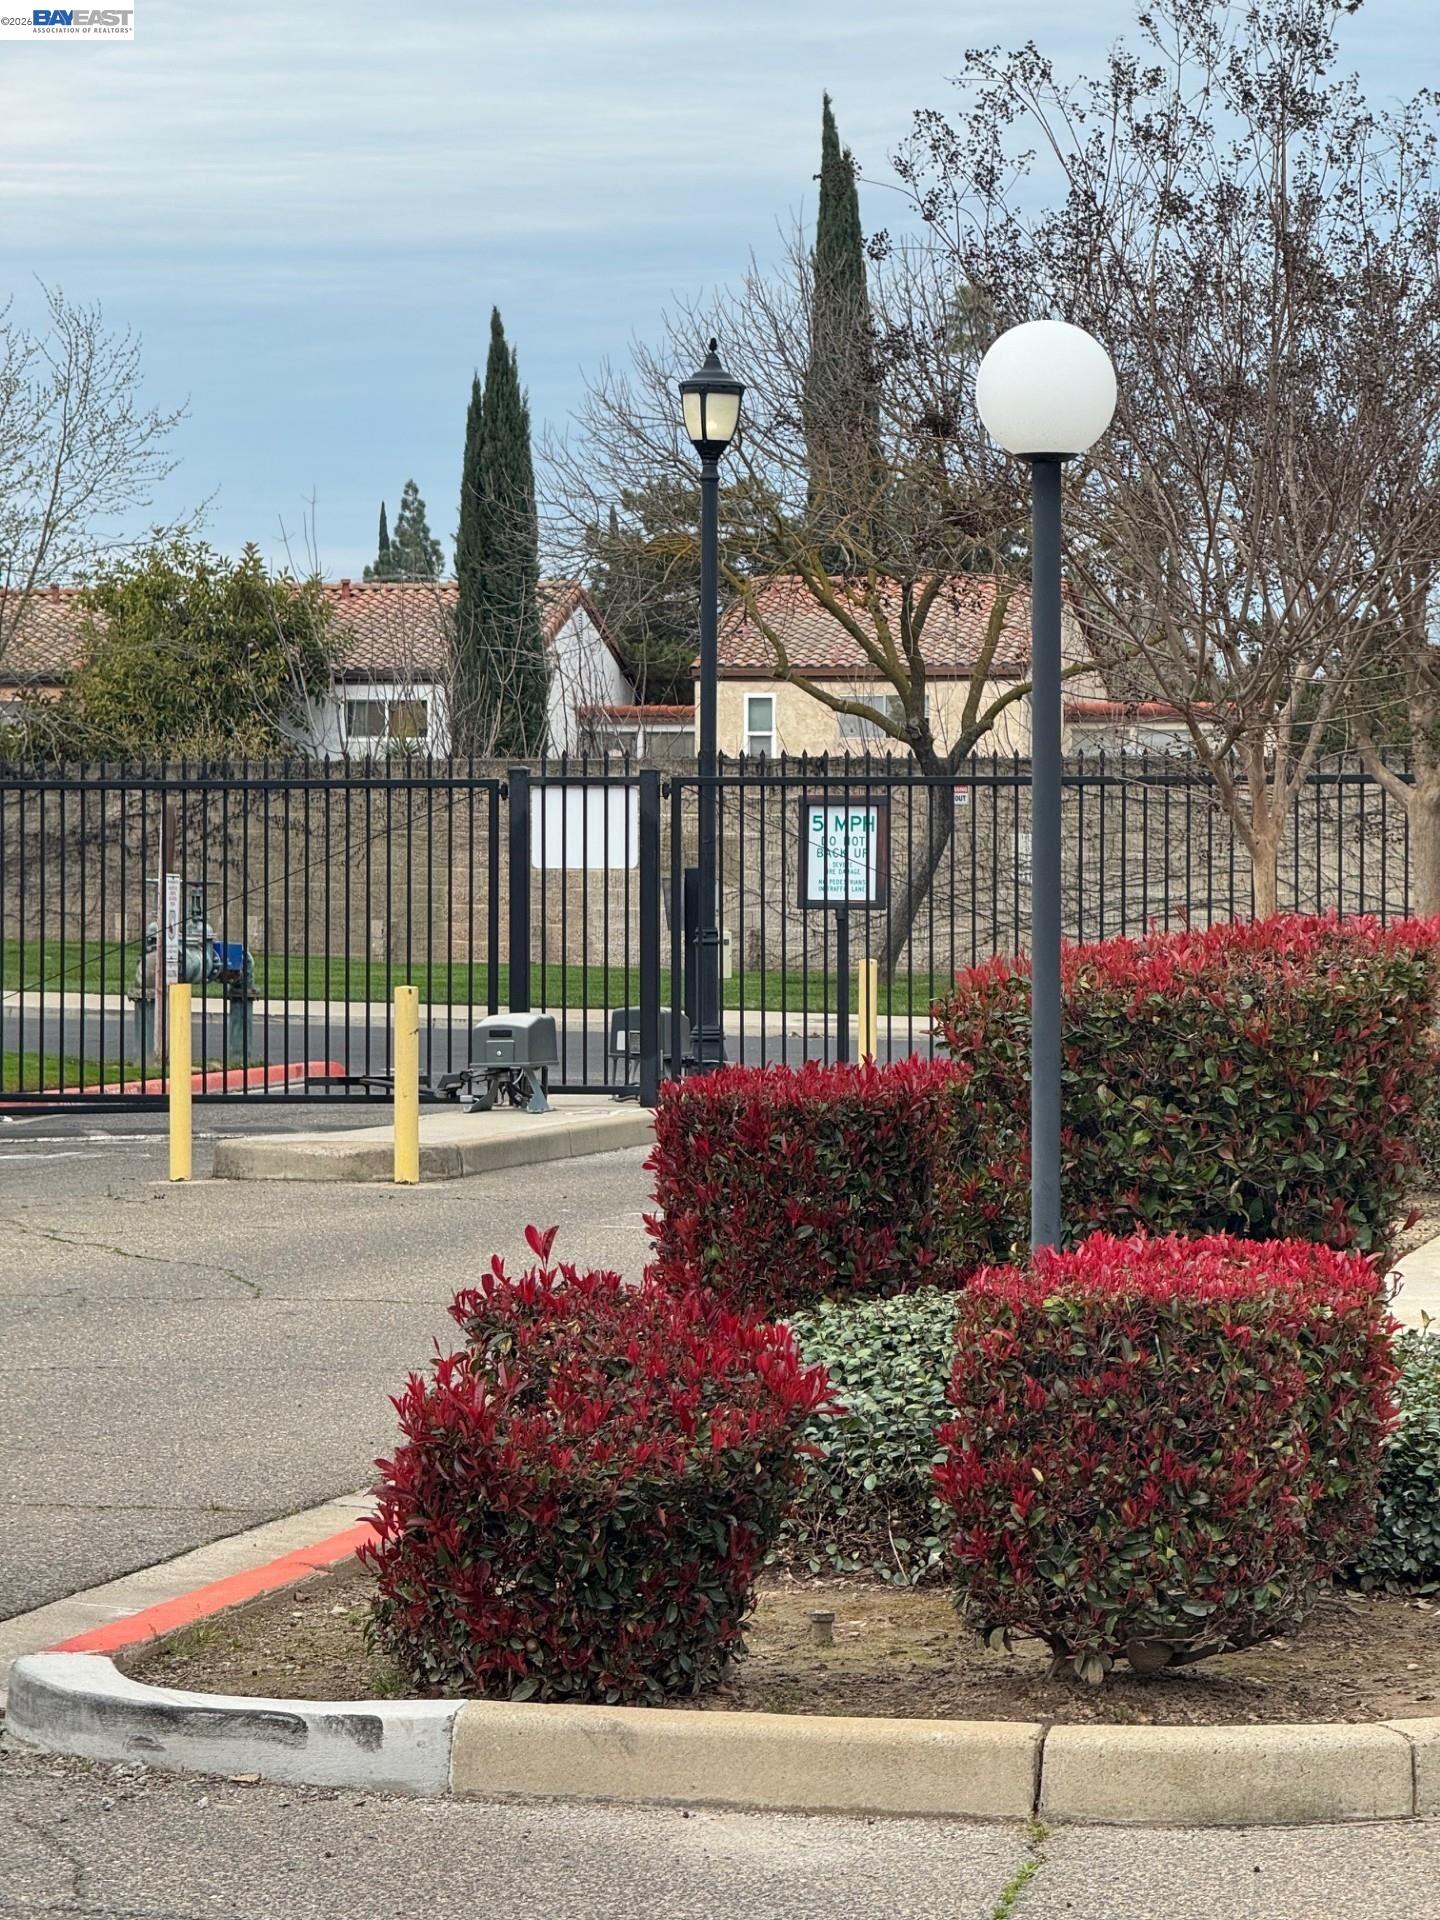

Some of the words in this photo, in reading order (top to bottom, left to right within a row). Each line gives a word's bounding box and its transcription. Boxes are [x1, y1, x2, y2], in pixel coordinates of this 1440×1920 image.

[812, 816, 824, 832] 5
[835, 816, 875, 832] MPH
[816, 848, 848, 858] BACK
